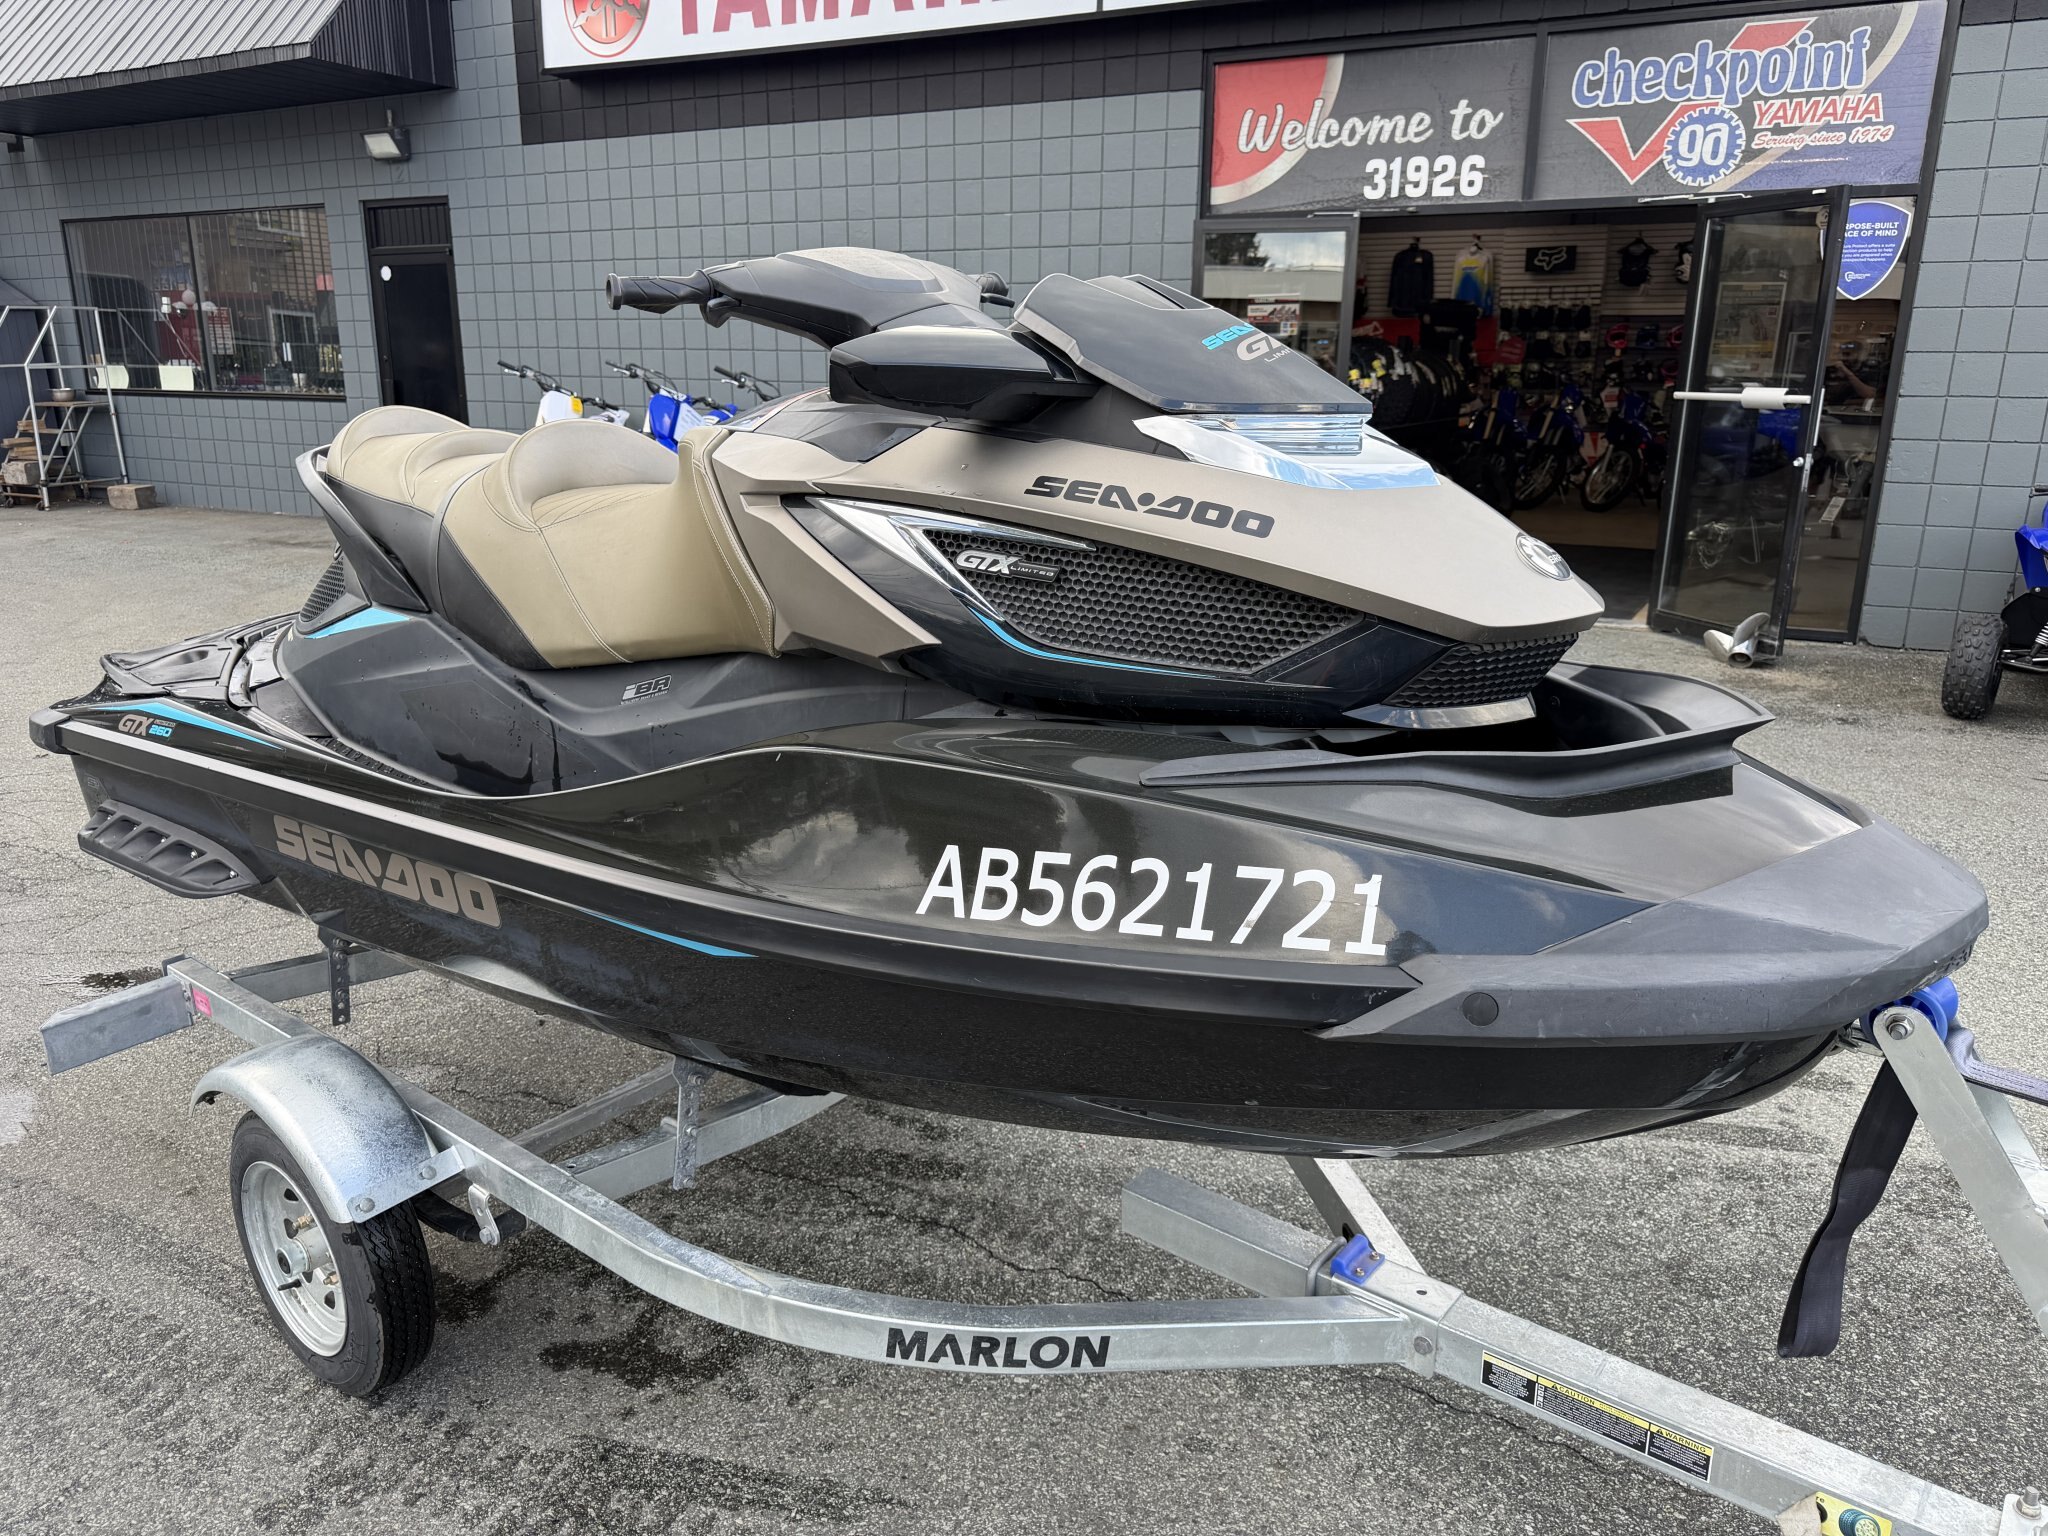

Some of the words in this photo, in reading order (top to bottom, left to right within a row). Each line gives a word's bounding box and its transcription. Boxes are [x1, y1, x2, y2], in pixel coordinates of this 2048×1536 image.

[1572, 26, 1872, 109] checkpoint
[1237, 98, 1434, 153] Welcome
[1450, 99, 1504, 141] to
[1753, 93, 1884, 129] YAMAHA
[1752, 132, 1805, 150] Serving
[1806, 132, 1845, 146] since
[1849, 125, 1895, 143] 1974
[1363, 154, 1486, 200] 31926
[956, 549, 1023, 575] GTX
[1010, 565, 1054, 577] LIMITED
[118, 713, 155, 737] GTX
[148, 724, 172, 738] 260
[915, 844, 1387, 956] AB5621721
[885, 1327, 1111, 1369] MARLON
[1559, 1386, 1595, 1406] CAUTION
[1665, 1431, 1706, 1453] WARNING
